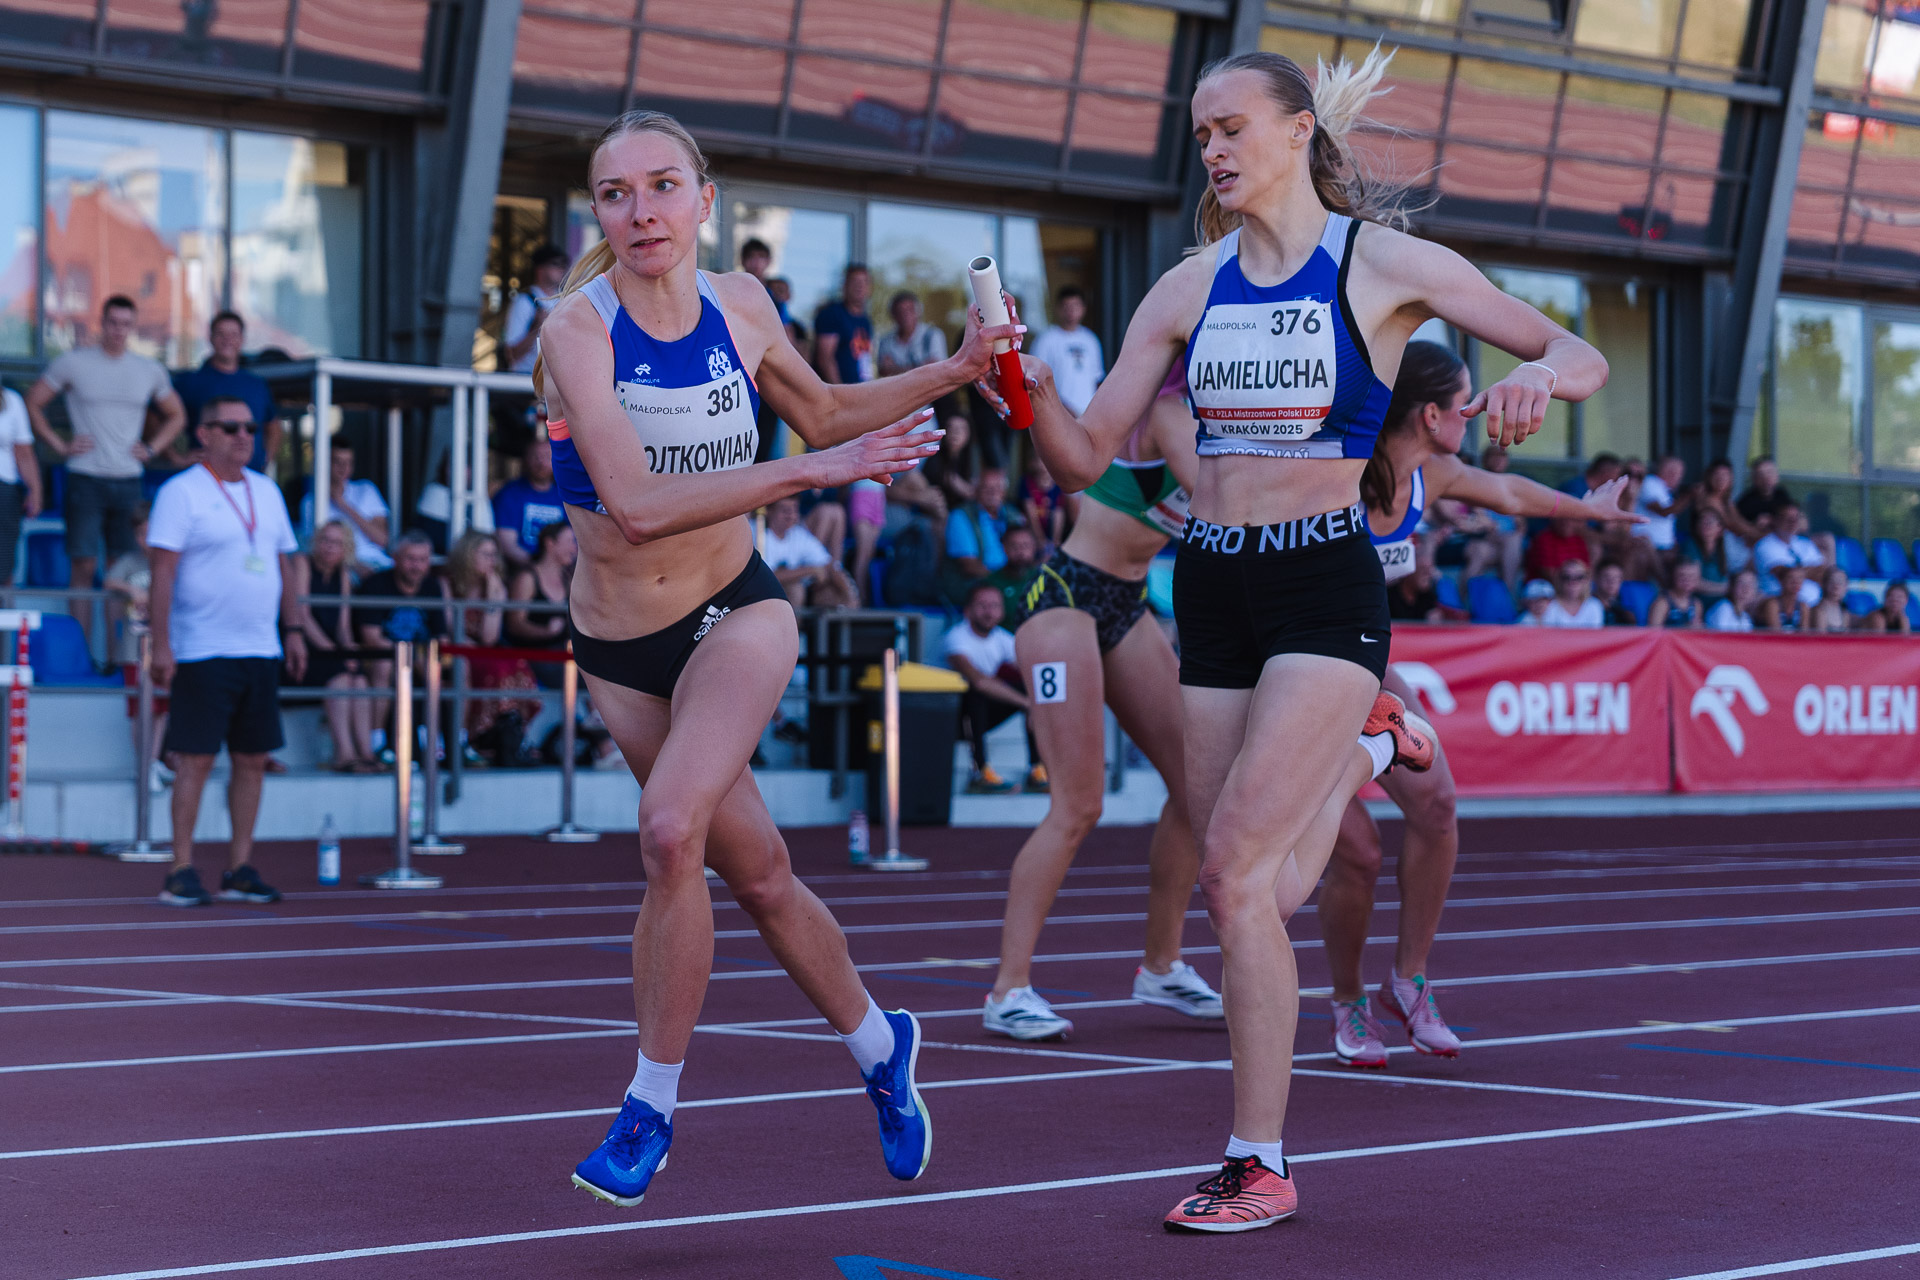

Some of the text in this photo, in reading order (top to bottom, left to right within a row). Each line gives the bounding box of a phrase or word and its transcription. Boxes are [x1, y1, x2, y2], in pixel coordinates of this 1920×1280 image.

[1206, 322, 1257, 331] MAŁOPOLSKA
[1271, 309, 1321, 336] 376
[1194, 359, 1329, 391] JAMIELUCHA
[629, 403, 692, 415] MAŁOPOLSKA
[707, 380, 740, 417] 387
[1234, 410, 1277, 418] Mistrzostwa
[1278, 409, 1302, 417] Polski
[1304, 409, 1320, 417] U23
[1221, 422, 1304, 435] KRAKÓW 2025
[644, 430, 753, 474] OJTKOWIAK
[1187, 518, 1246, 554] PRO
[1258, 509, 1349, 553] NIKE
[1381, 546, 1410, 566] 320
[1040, 667, 1057, 699] 8
[1485, 680, 1630, 737] ORLEN
[1793, 683, 1918, 736] ORLEN
